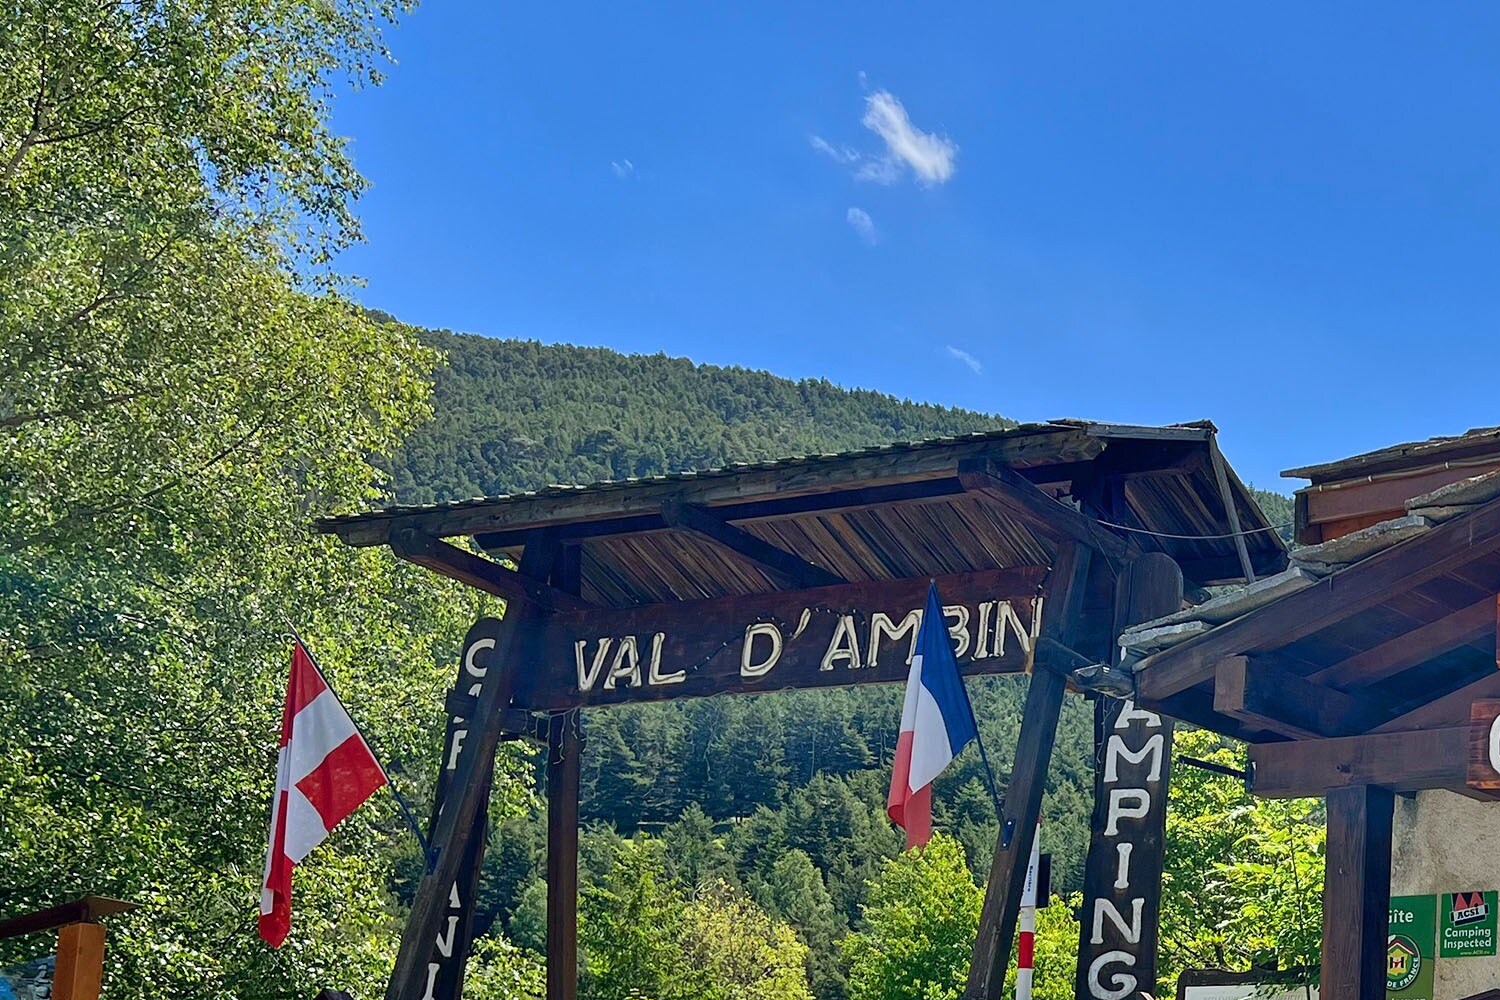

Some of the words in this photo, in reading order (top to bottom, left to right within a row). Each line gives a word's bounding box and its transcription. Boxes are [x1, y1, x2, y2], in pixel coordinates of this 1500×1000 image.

[575, 632, 687, 691] VAL
[740, 597, 1044, 677] D'AMBIN
[1087, 646, 1165, 1000] AMPING
[1457, 907, 1480, 920] ACSI
[1445, 926, 1491, 938] Camping
[1444, 938, 1492, 950] Inspected
[1387, 980, 1397, 988] DE
[1400, 957, 1419, 987] FRANCE
